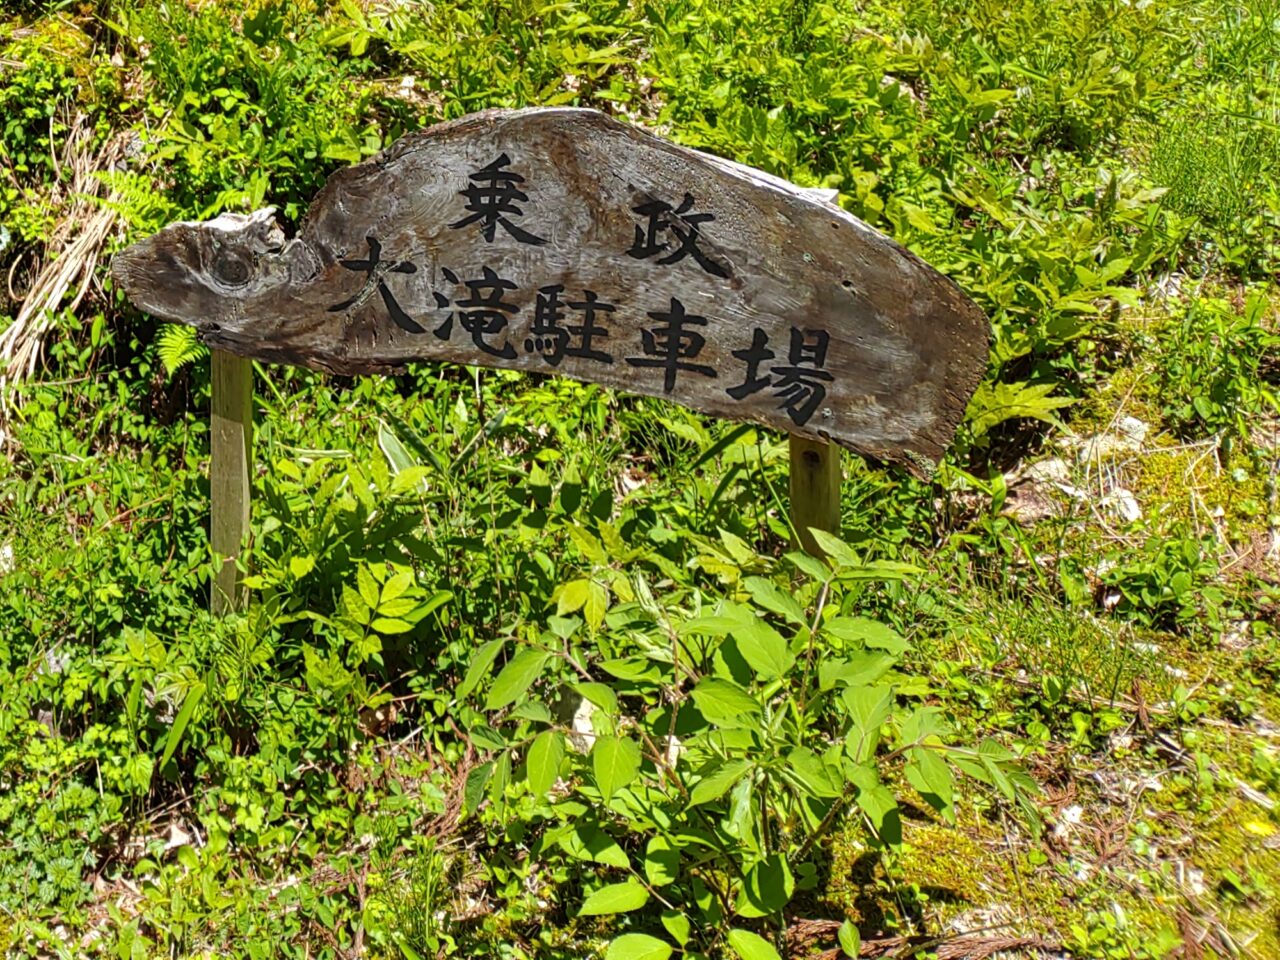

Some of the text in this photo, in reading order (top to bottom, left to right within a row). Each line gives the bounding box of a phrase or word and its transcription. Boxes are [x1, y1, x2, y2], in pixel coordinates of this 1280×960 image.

[448, 152, 733, 278] 乗政
[329, 238, 834, 427] 大滝駐車場
